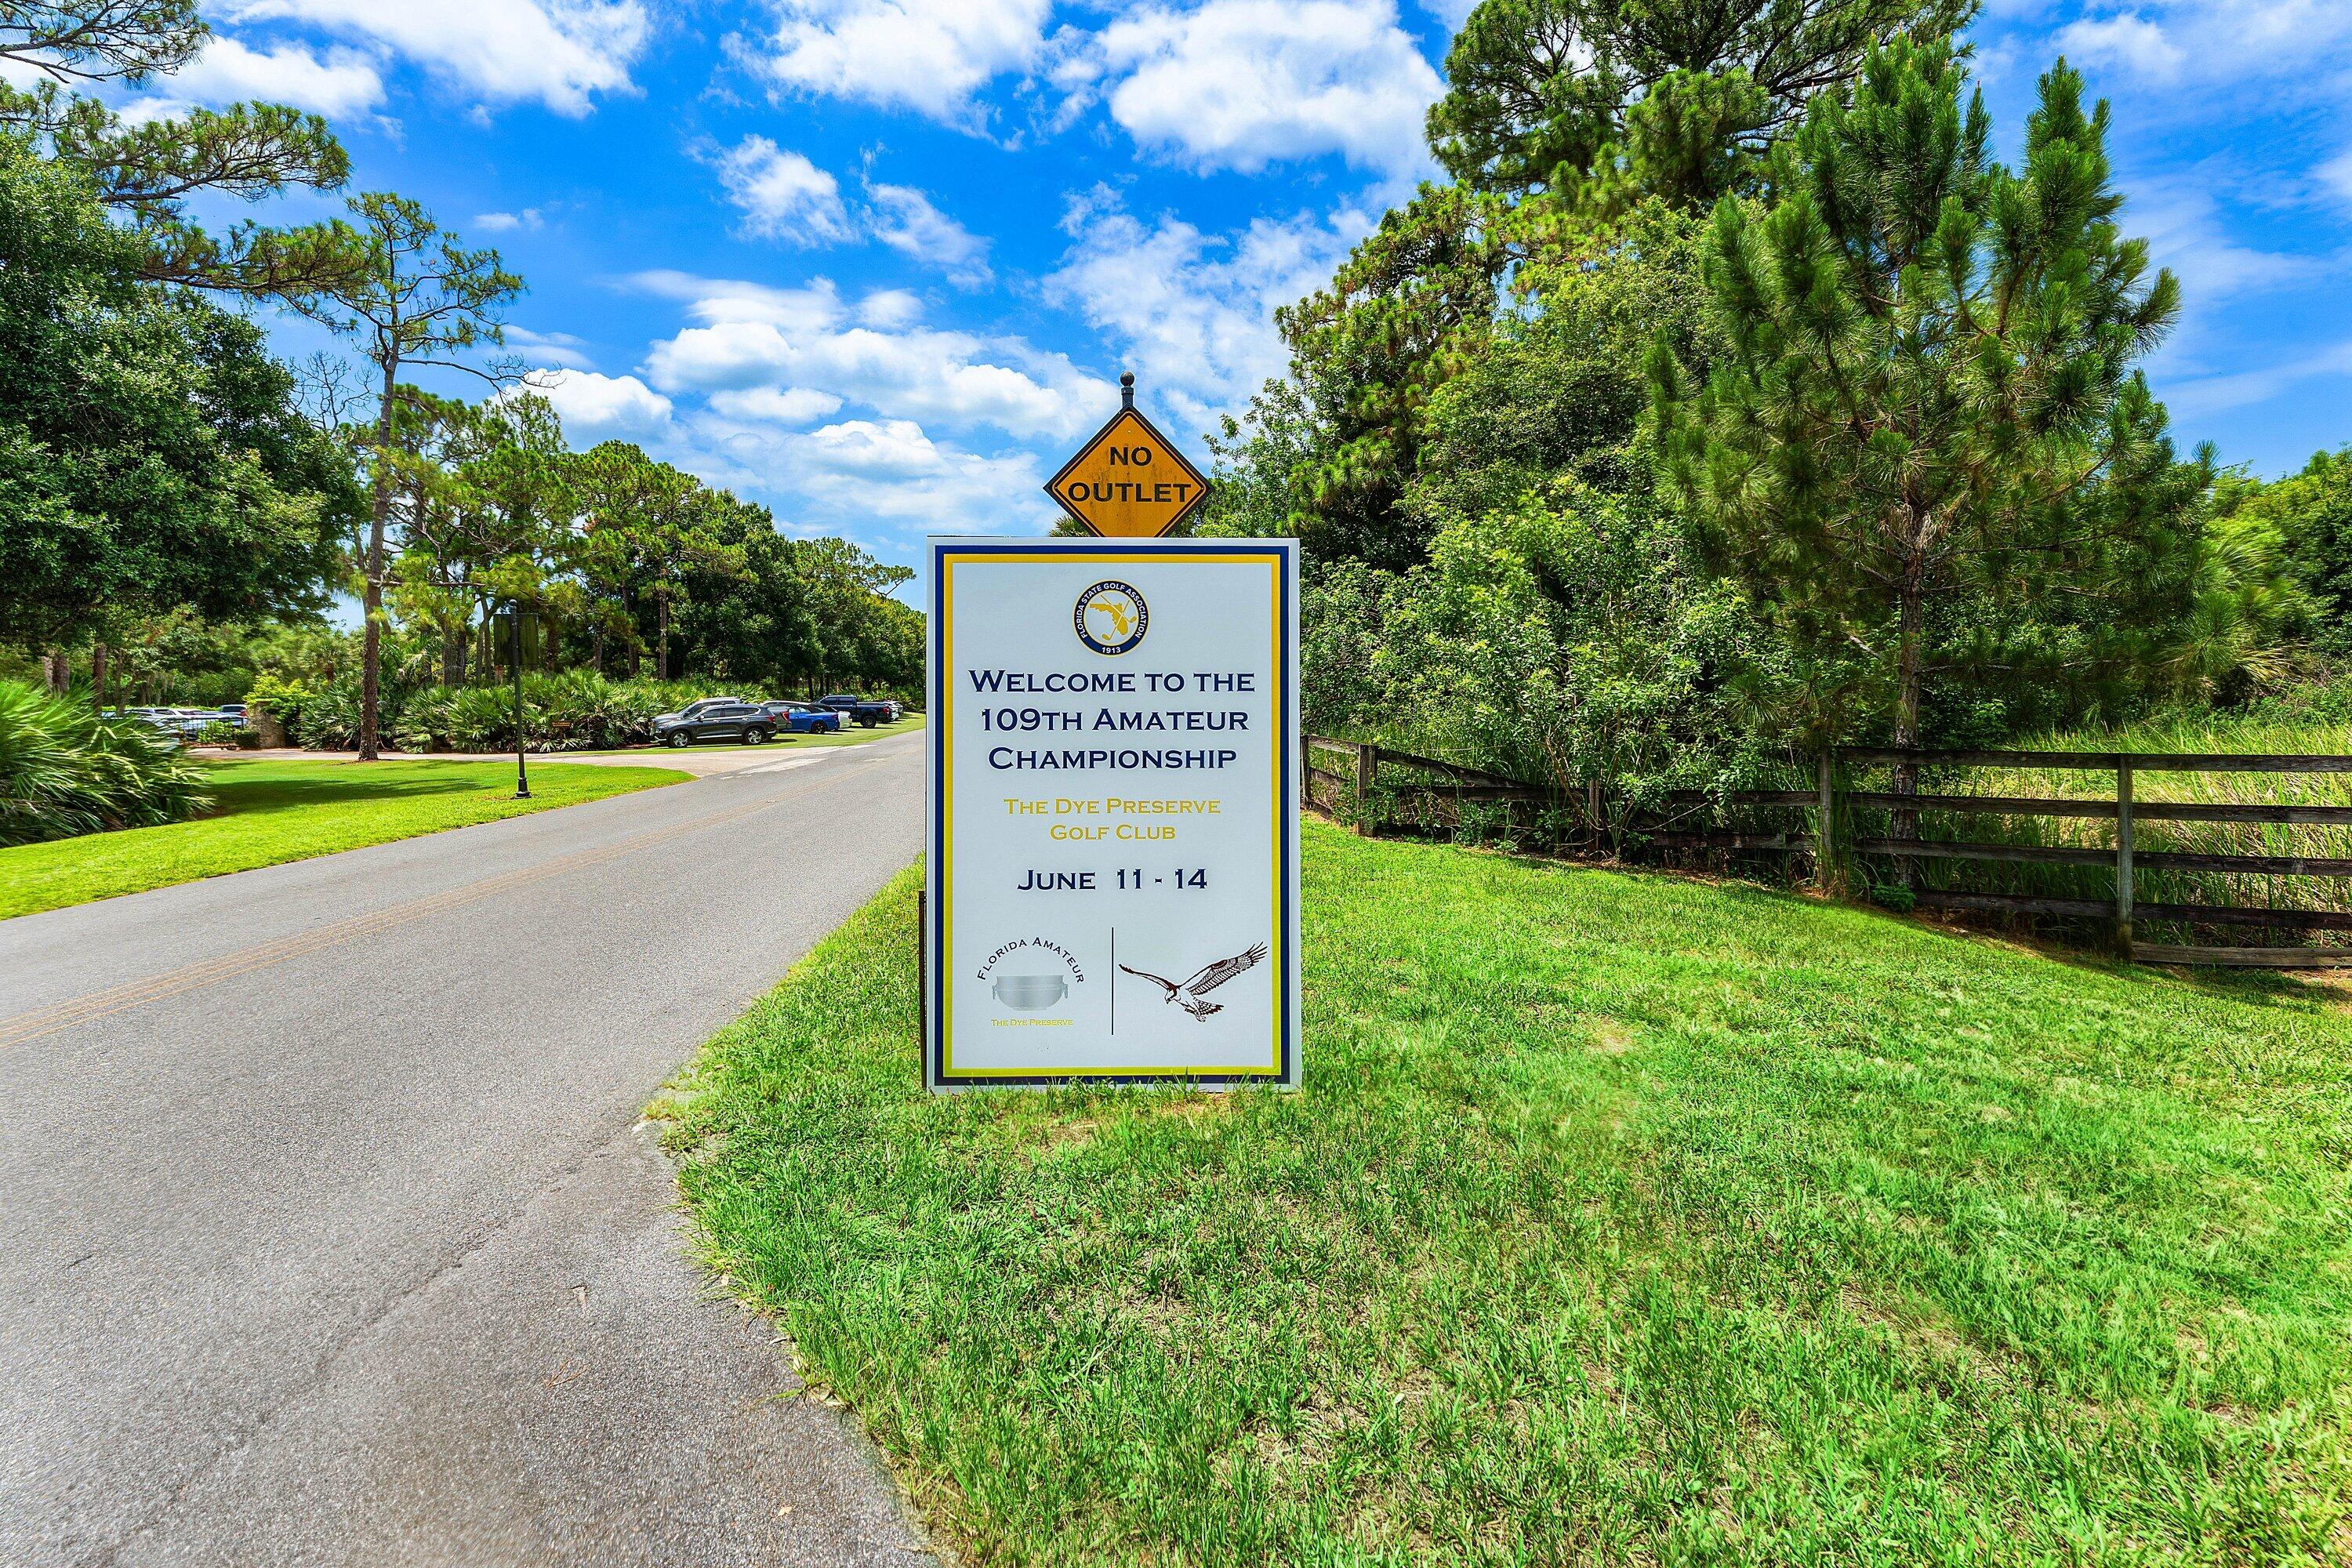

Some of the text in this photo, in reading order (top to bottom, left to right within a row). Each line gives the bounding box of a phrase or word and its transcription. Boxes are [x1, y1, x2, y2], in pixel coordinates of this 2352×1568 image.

[1109, 446, 1152, 466] NO
[1068, 481, 1192, 503] OUTLET
[1081, 585, 1102, 604] STATE
[1076, 604, 1088, 638] FLORIDA
[1125, 588, 1147, 638] ASSOCIATION
[1116, 869, 1142, 890] 11
[1174, 869, 1208, 890] 14
